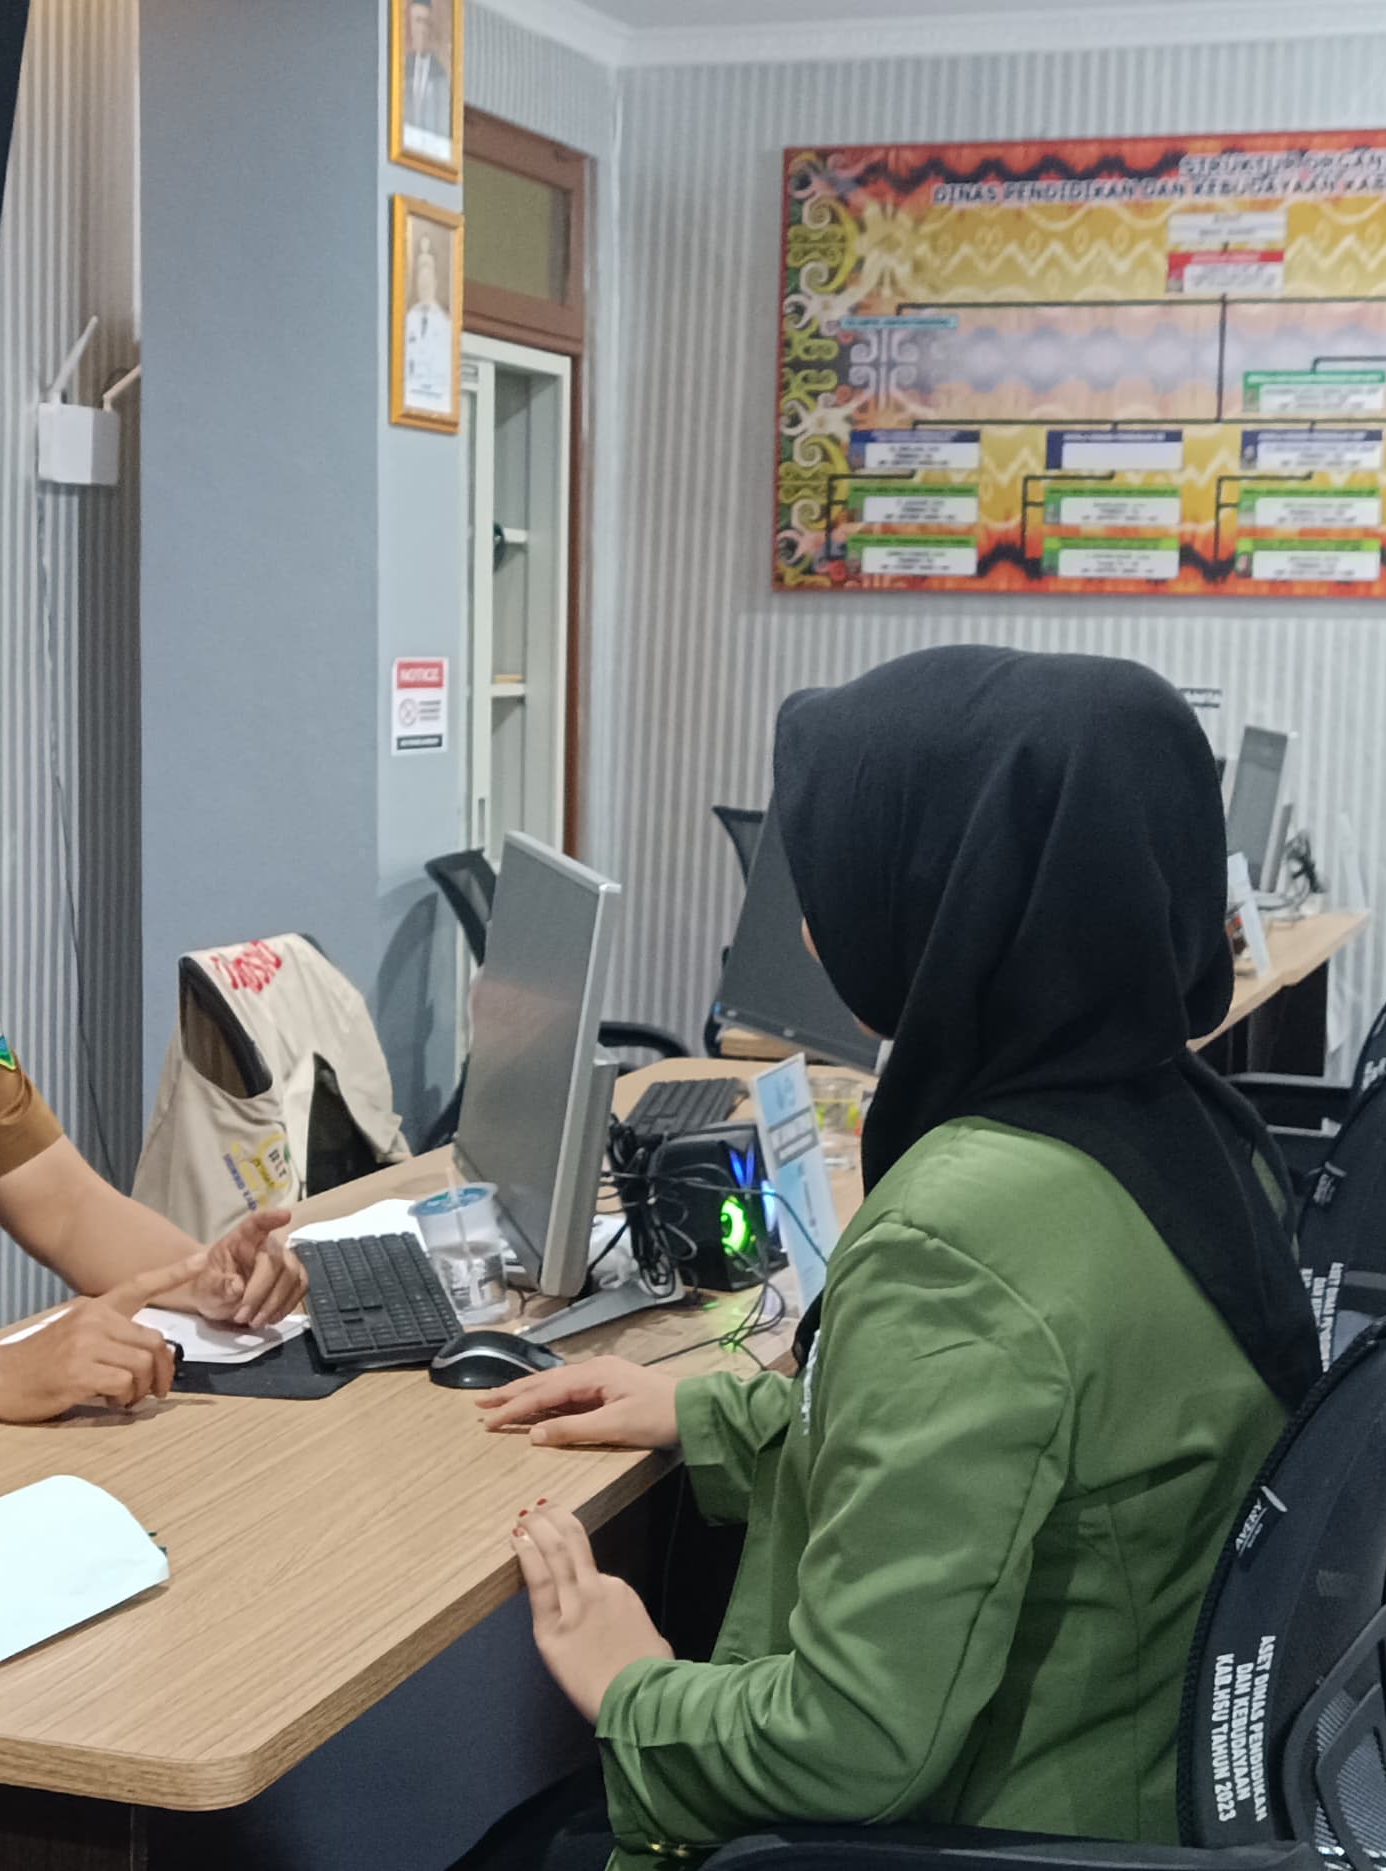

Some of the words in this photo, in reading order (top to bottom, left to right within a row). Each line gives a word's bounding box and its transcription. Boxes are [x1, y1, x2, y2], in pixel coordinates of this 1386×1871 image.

[933, 182, 998, 204] DINAS
[1004, 178, 1135, 203] PENDIDIKAN
[1141, 177, 1186, 200] DAN
[1255, 1635, 1277, 1671] ASET
[1234, 1662, 1255, 1696] DAN
[1250, 1673, 1270, 1722] DINAS
[1211, 1723, 1231, 1781] TAHUN
[1230, 1698, 1251, 1802] KEBUDAYAAN
[1249, 1722, 1268, 1822] PENDIDIKAN
[1214, 1780, 1237, 1823] 2023
